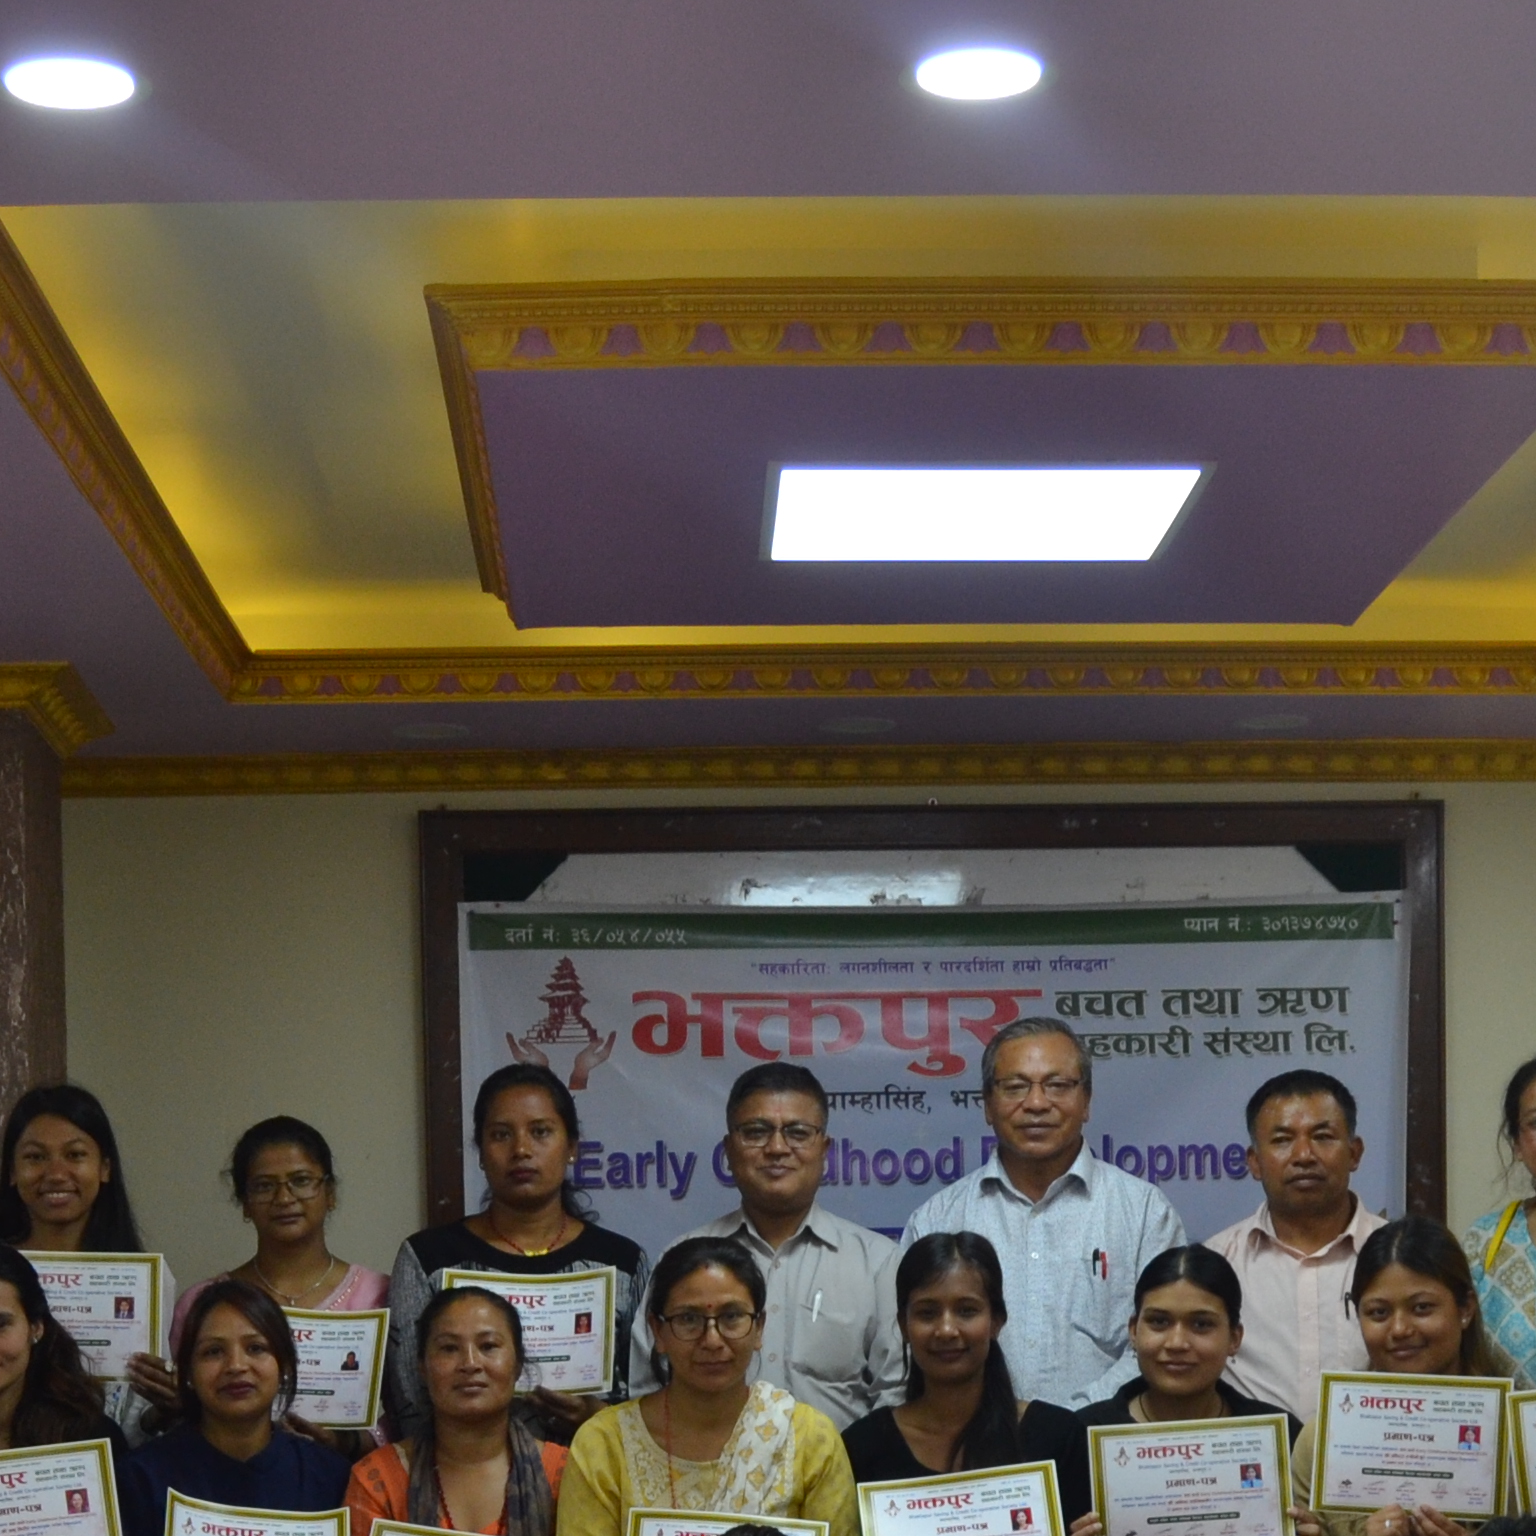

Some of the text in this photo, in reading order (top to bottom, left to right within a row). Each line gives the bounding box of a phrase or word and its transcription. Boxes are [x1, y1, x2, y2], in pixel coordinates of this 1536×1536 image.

[922, 961, 932, 974] र
[1055, 986, 1351, 1019] बचत तथा ऋण
[631, 988, 1043, 1078] भक्तपुर
[1076, 1021, 1357, 1060] हकारी संस्था लि.
[574, 1141, 696, 1199] Early
[1360, 1397, 1427, 1414] भक्तपुर
[1136, 1444, 1205, 1460] भक्तपुर
[906, 1493, 973, 1510] भक्तपुर
